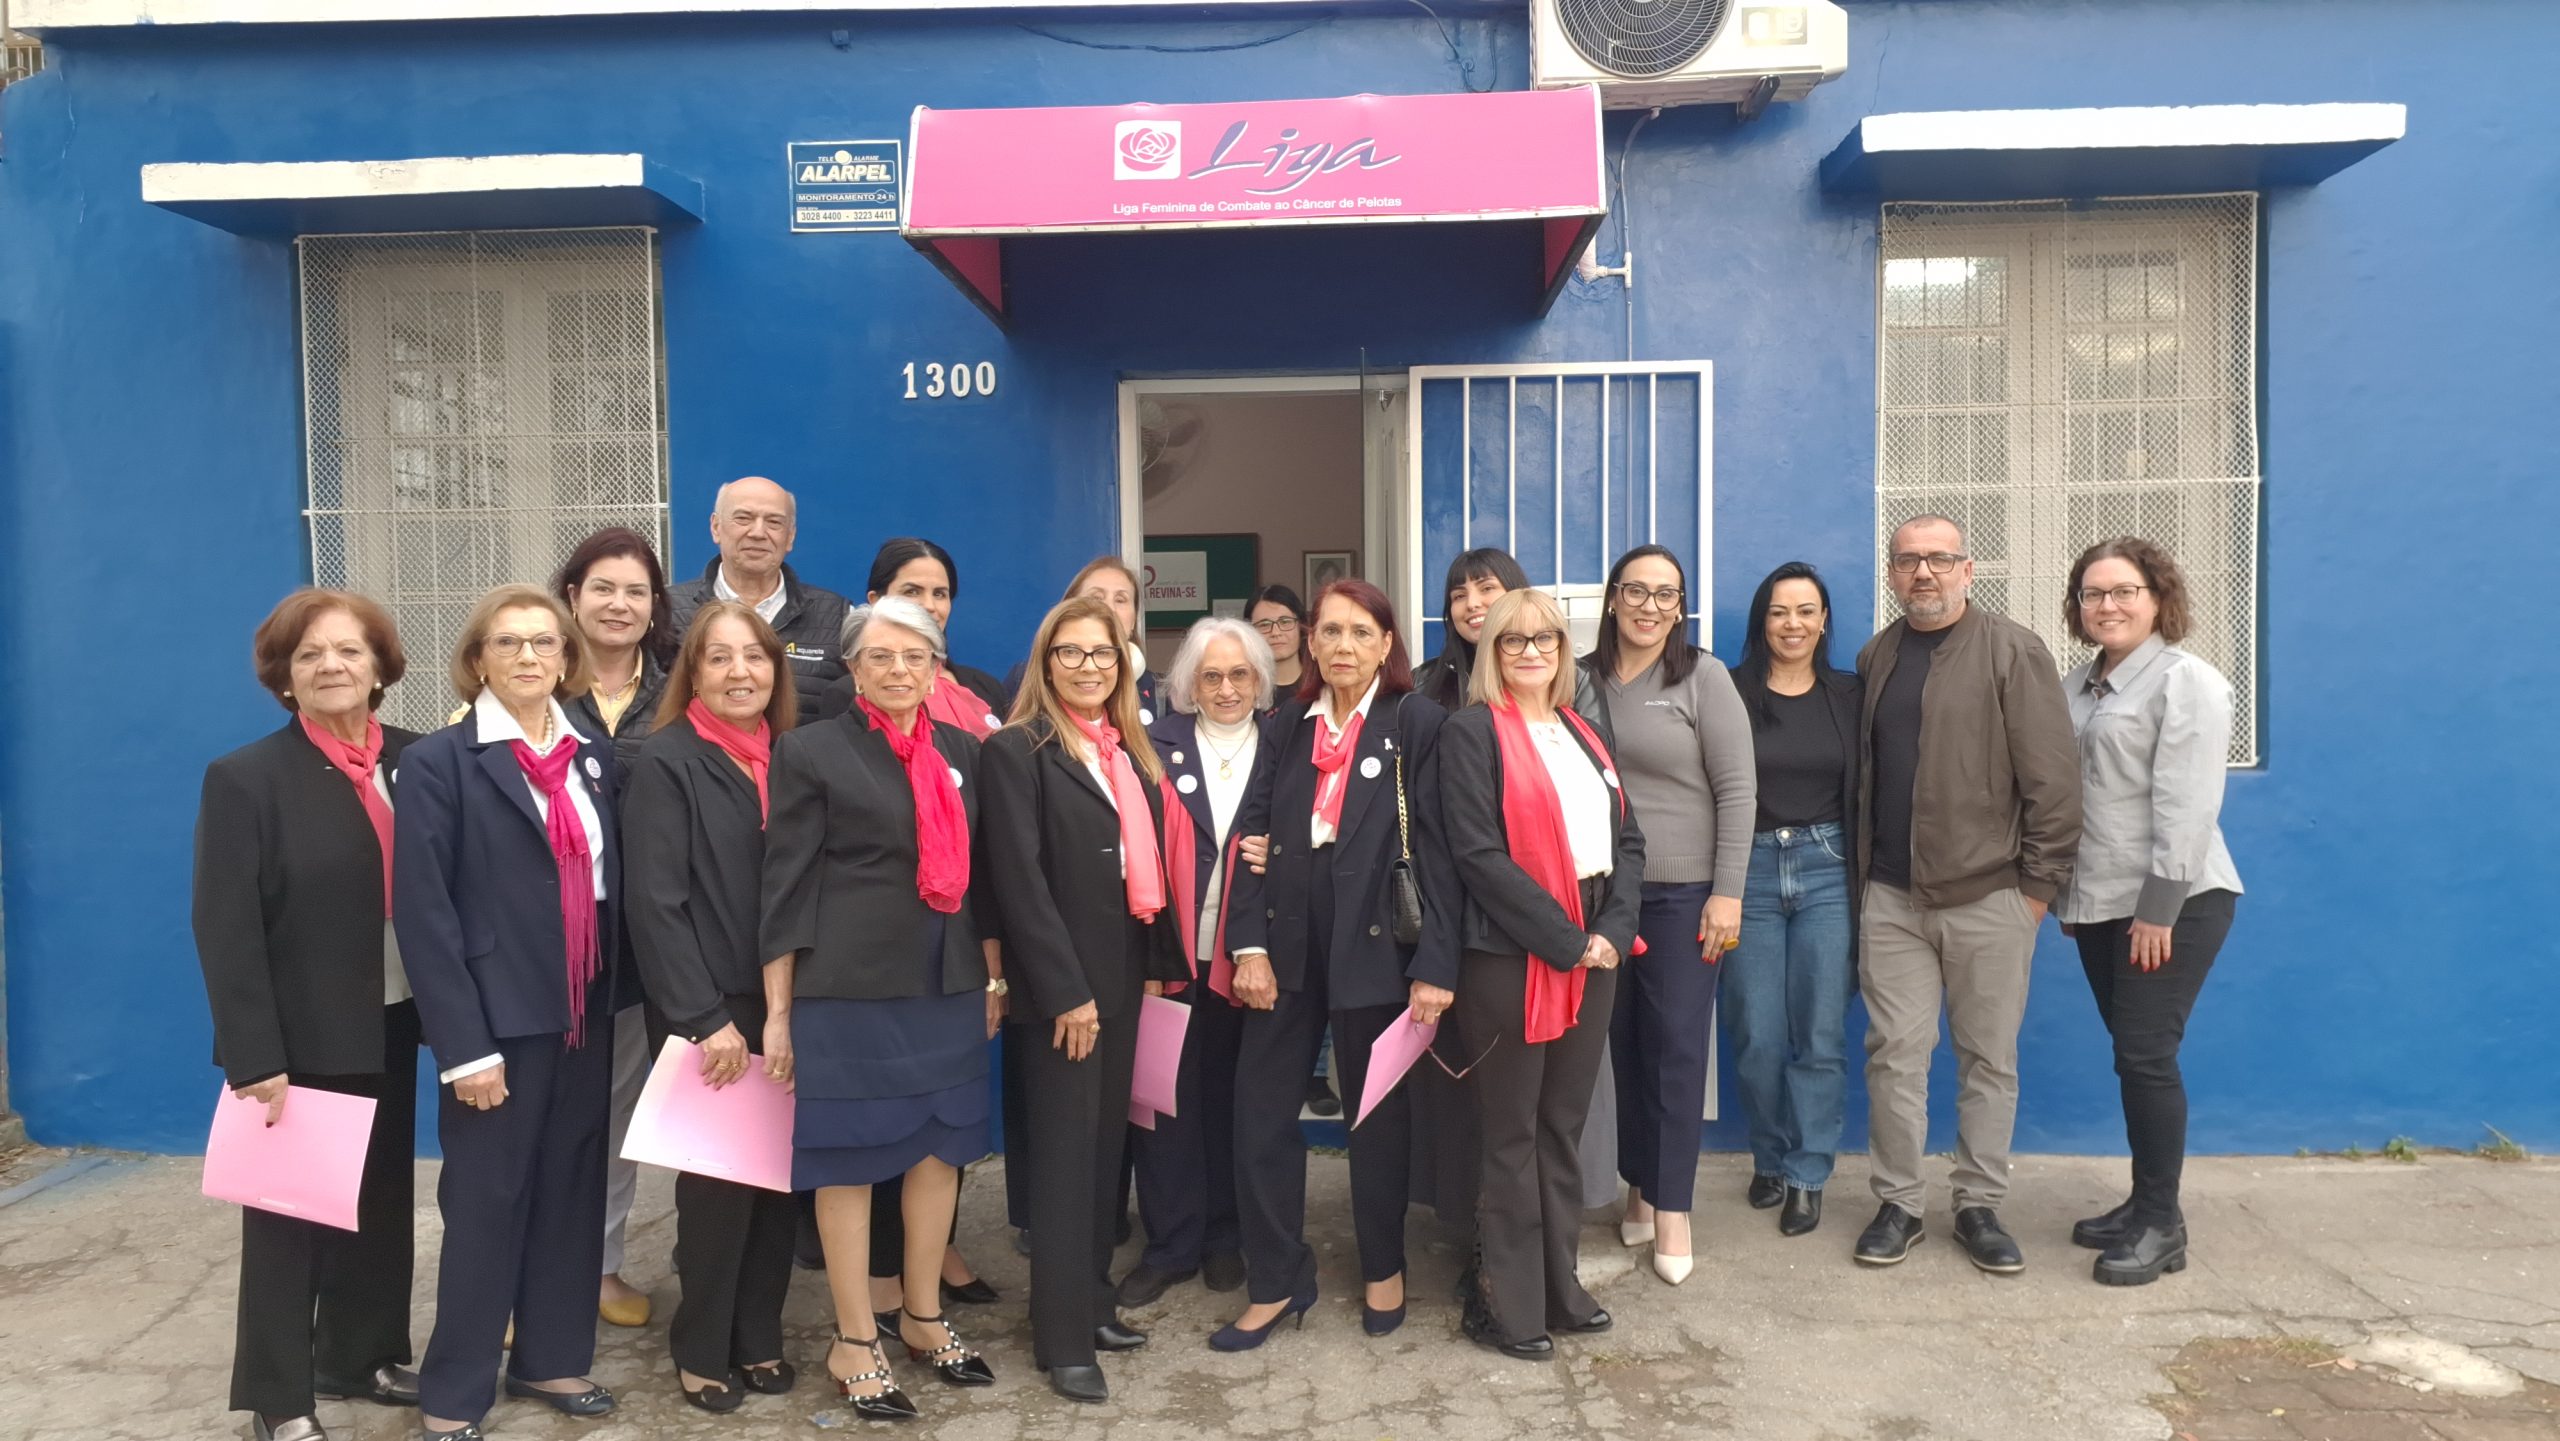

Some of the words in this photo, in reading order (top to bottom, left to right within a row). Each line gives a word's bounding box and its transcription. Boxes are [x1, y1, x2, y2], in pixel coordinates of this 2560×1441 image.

[1187, 119, 1402, 195] Liga
[800, 164, 892, 183] ALARPEL
[801, 212, 821, 221] 3028
[822, 212, 842, 221] 4400
[853, 211, 873, 220] 3223
[874, 211, 893, 219] 4411
[1113, 203, 1139, 216] Liga
[1142, 202, 1197, 213] Feminina
[1199, 202, 1215, 212] de
[1217, 200, 1272, 211] Combate
[1274, 201, 1290, 210] ao
[1292, 198, 1336, 210] Câncer
[1338, 198, 1354, 208] de
[1357, 196, 1402, 208] Pelotas
[902, 361, 996, 399] 1300
